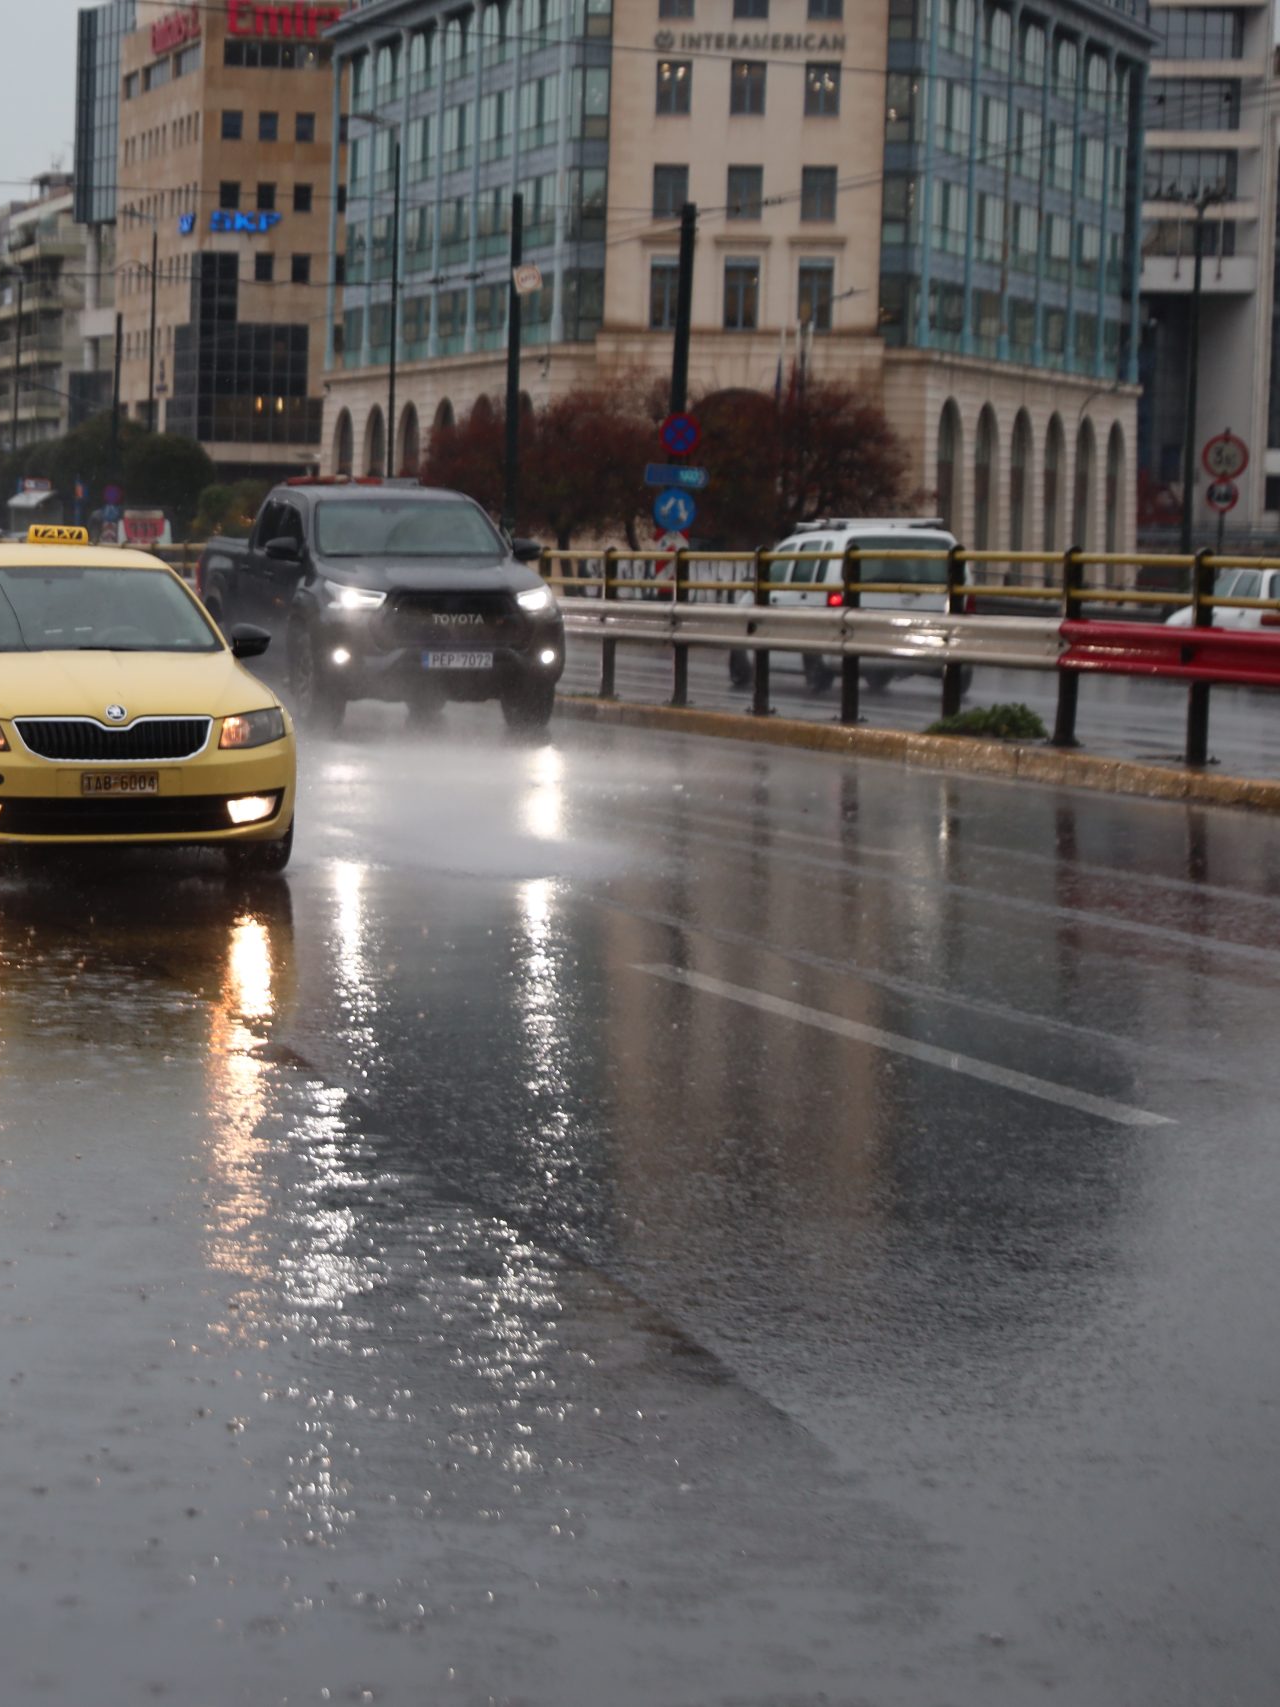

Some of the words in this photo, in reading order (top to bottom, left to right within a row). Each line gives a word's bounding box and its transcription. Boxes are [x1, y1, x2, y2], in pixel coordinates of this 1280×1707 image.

[681, 33, 846, 50] INTERAMERICAN
[35, 528, 83, 540] TAXI
[432, 613, 485, 625] TOYOTA
